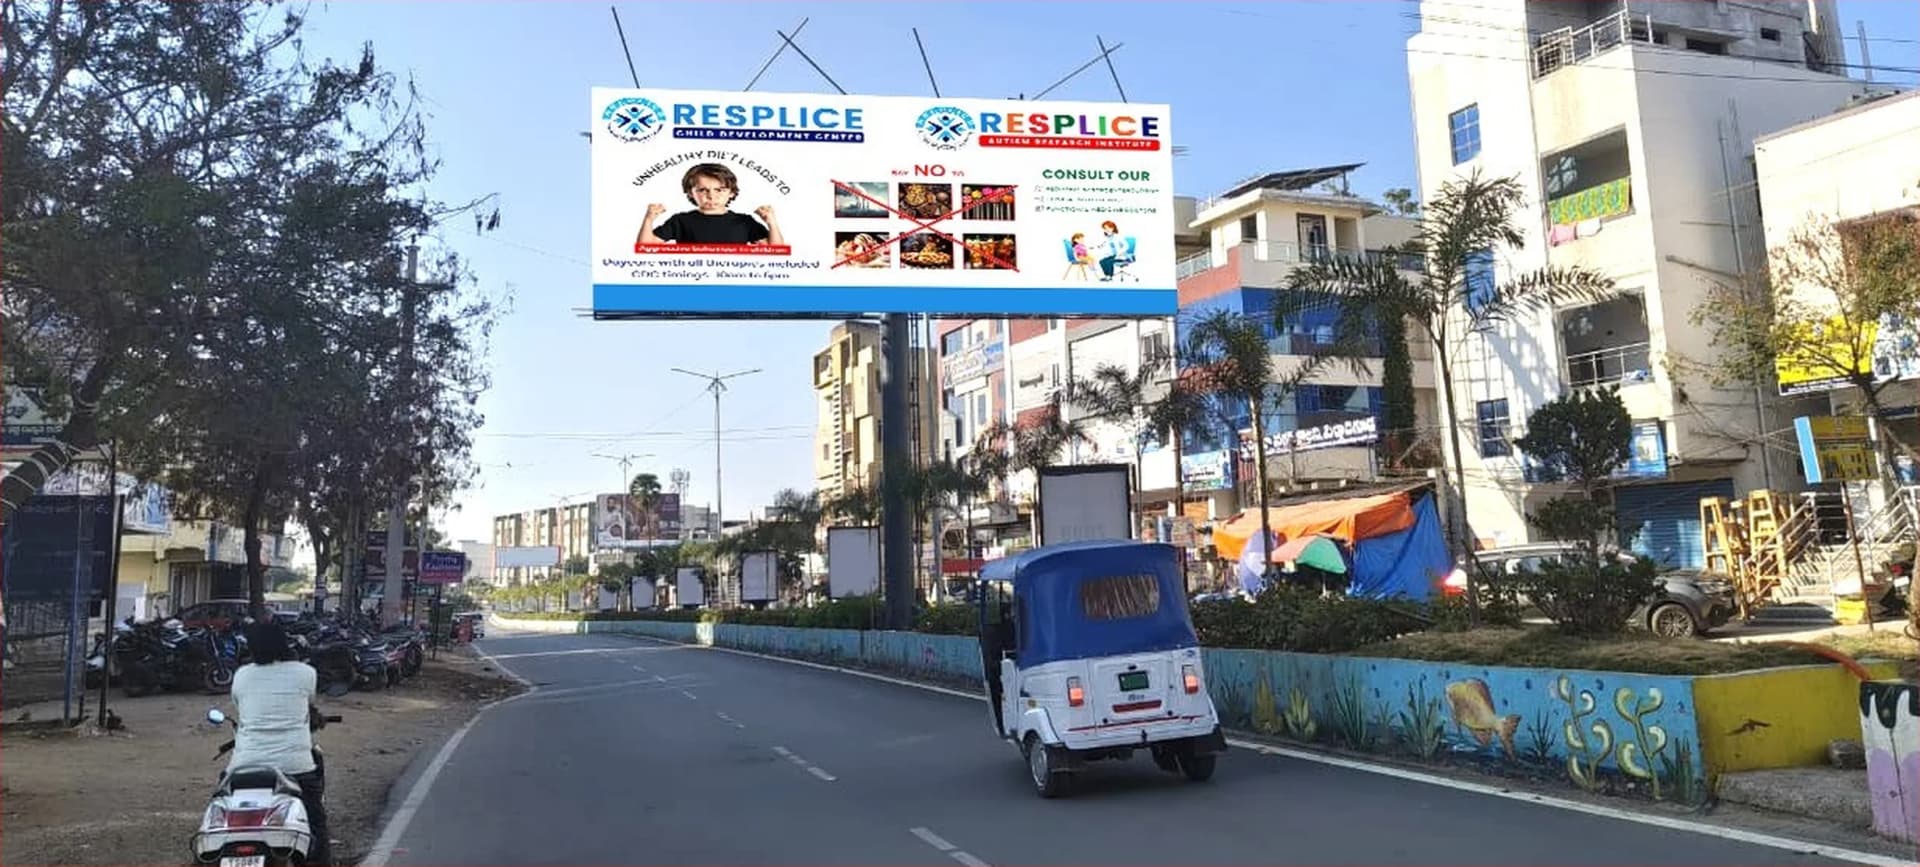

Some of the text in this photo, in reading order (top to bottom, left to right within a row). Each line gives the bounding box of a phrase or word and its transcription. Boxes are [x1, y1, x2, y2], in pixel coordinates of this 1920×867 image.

[674, 104, 863, 129] RESPLICE
[980, 112, 1159, 137] RESPLICE
[676, 129, 862, 141] CHILD DEVELOPMENT CENTER
[1095, 139, 1152, 147] INSTITUTE
[632, 150, 791, 195] UNHEALTHY DIET LEADS TO
[914, 164, 946, 177] NO
[1042, 168, 1150, 182] CONSULT OUR
[602, 258, 820, 269] Daycare with all therapies included
